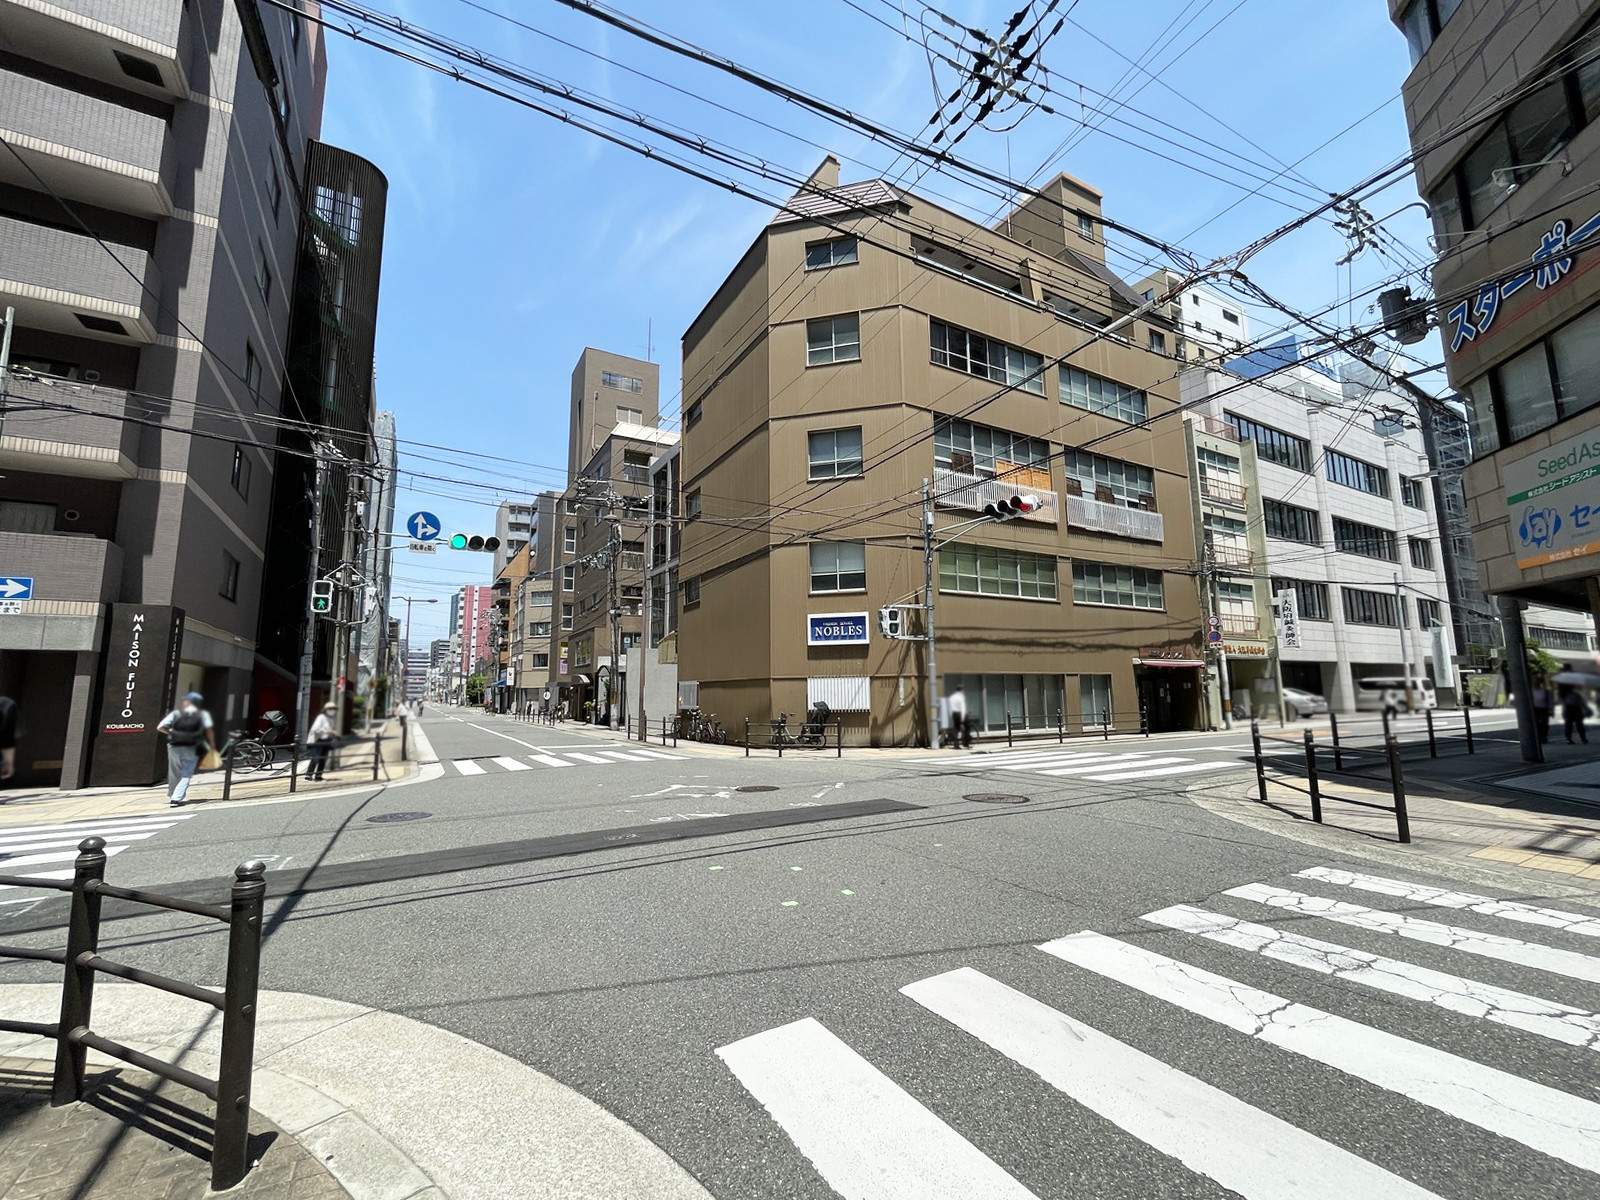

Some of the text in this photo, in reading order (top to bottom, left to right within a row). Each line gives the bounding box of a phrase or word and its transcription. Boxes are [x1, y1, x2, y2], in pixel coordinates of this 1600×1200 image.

[815, 625, 862, 637] NOBLES
[121, 613, 145, 718] MAISON FUJIO
